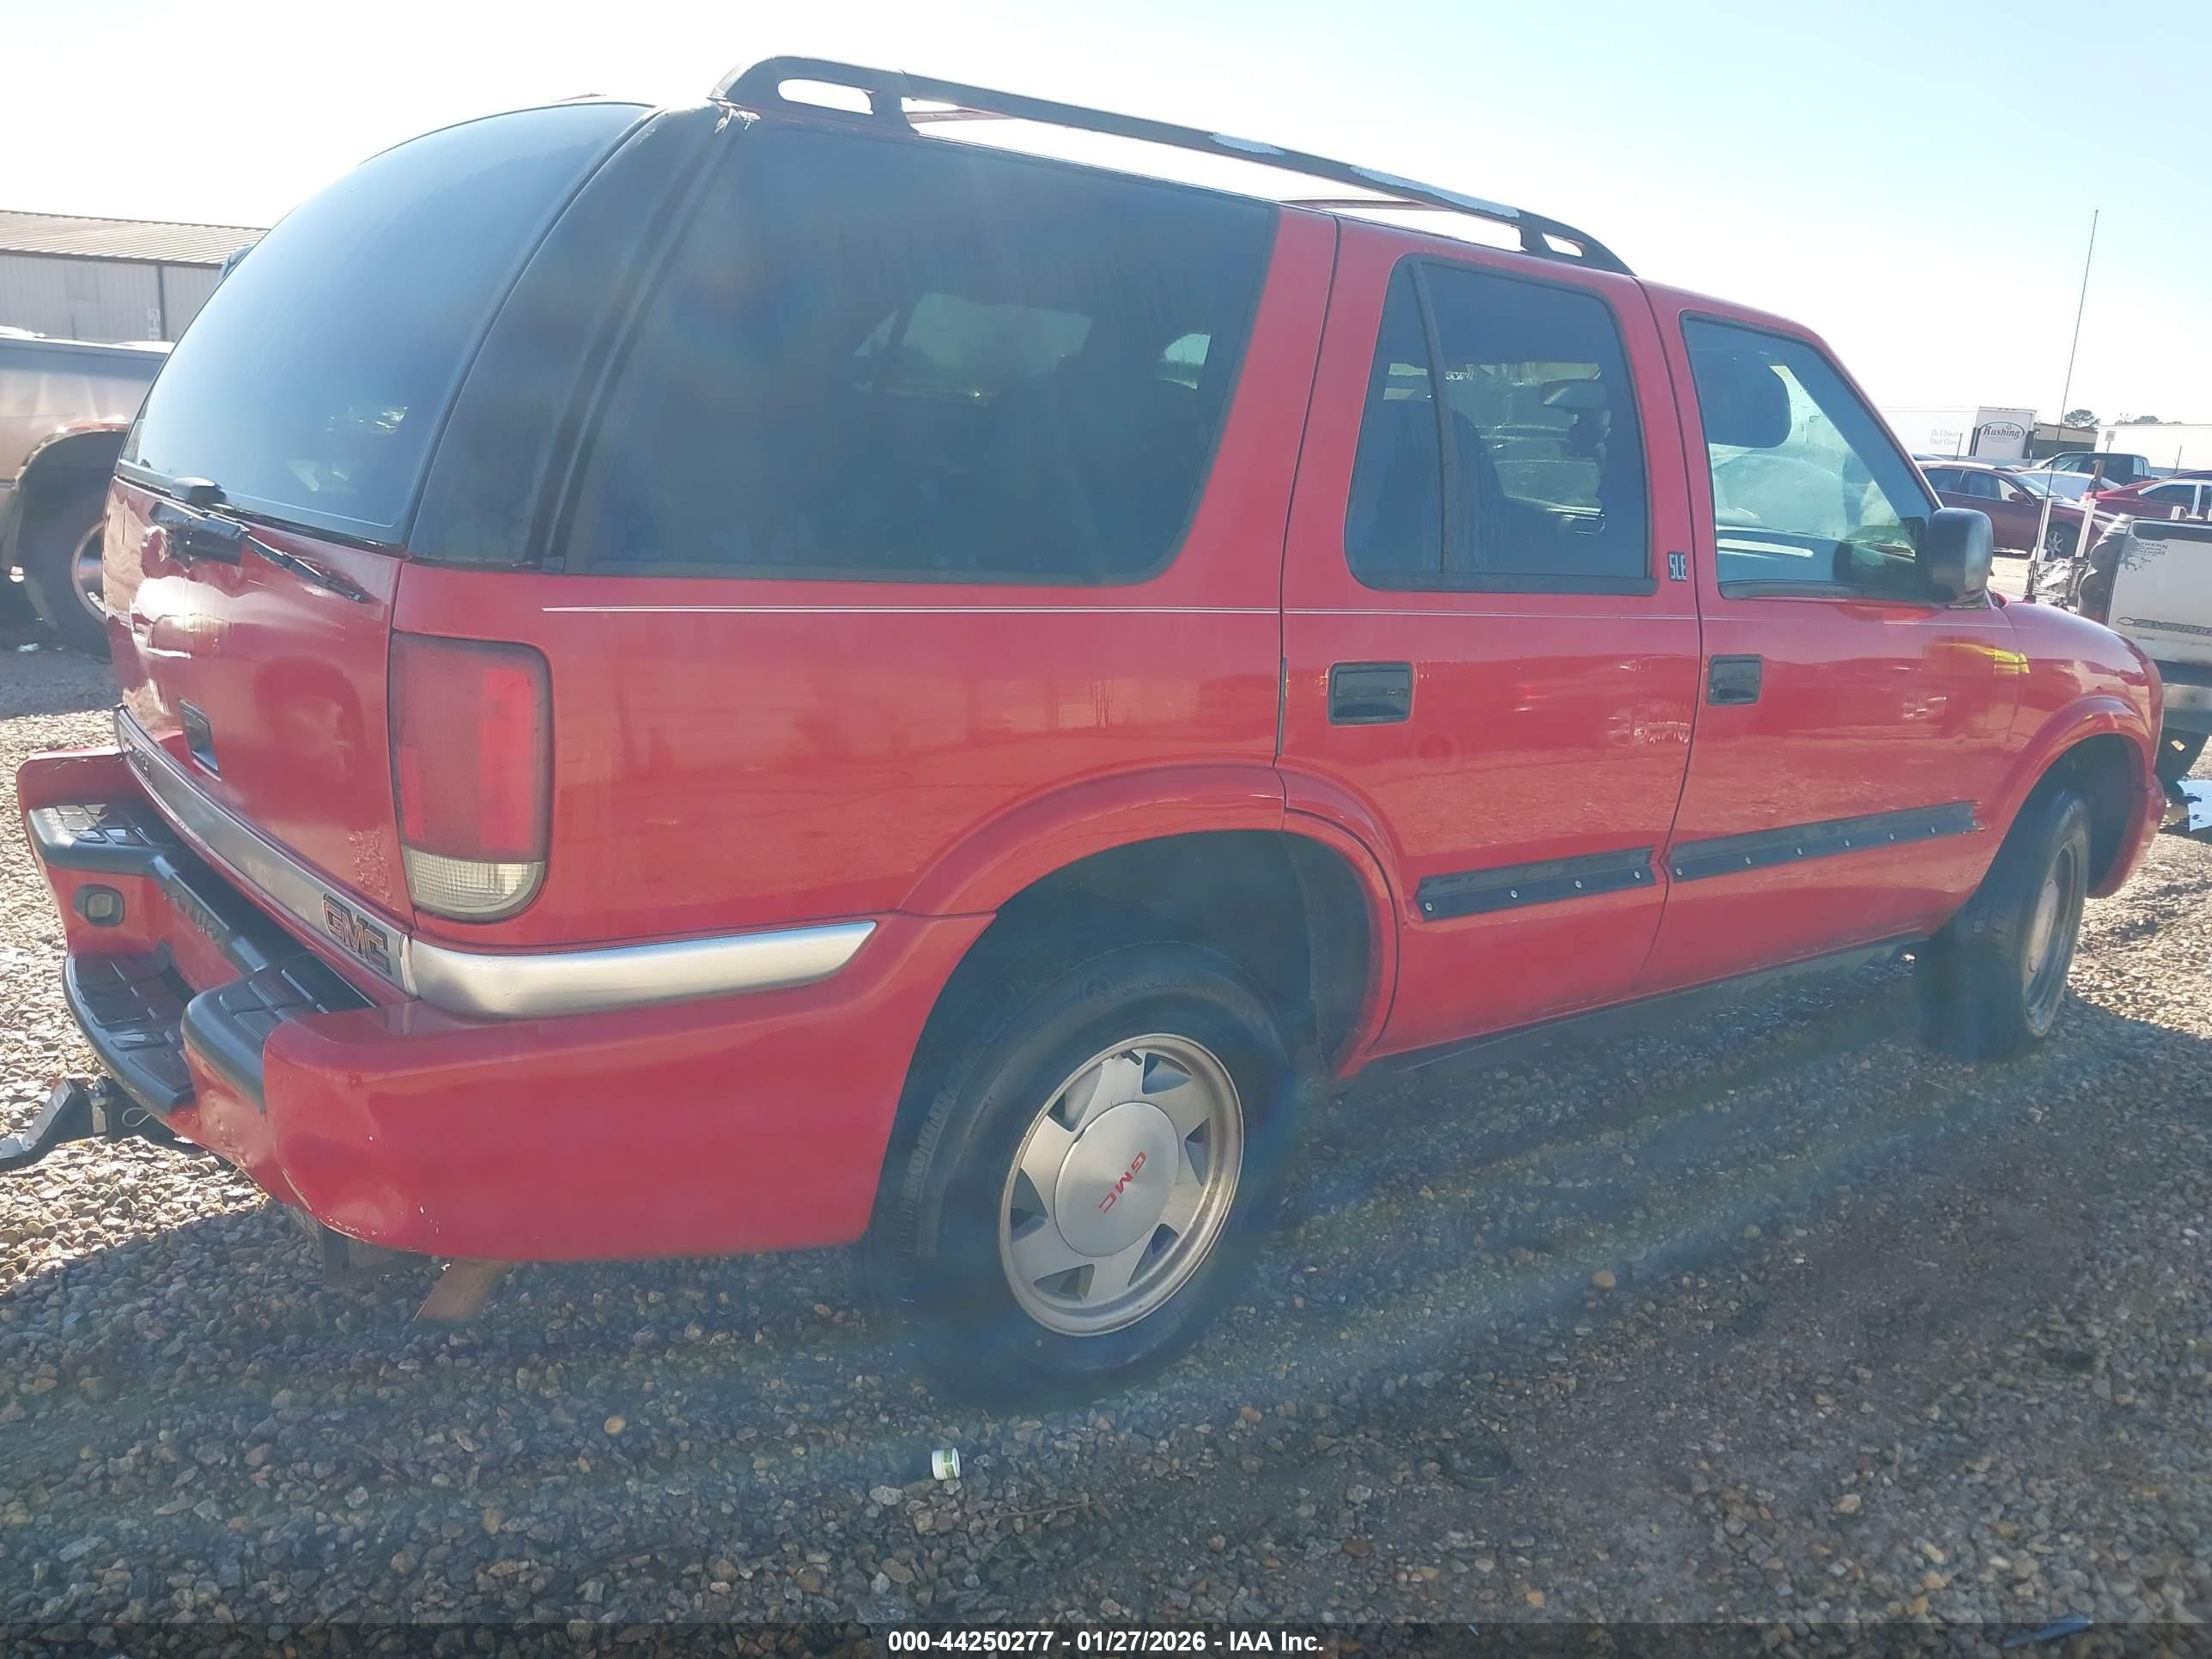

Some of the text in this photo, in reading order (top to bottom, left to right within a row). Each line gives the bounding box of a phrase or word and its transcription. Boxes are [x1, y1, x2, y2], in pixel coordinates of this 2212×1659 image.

[1983, 425, 2021, 440] Rushing
[1668, 553, 1687, 580] SLE
[322, 892, 392, 975] GMC
[1098, 1151, 1147, 1214] GMC
